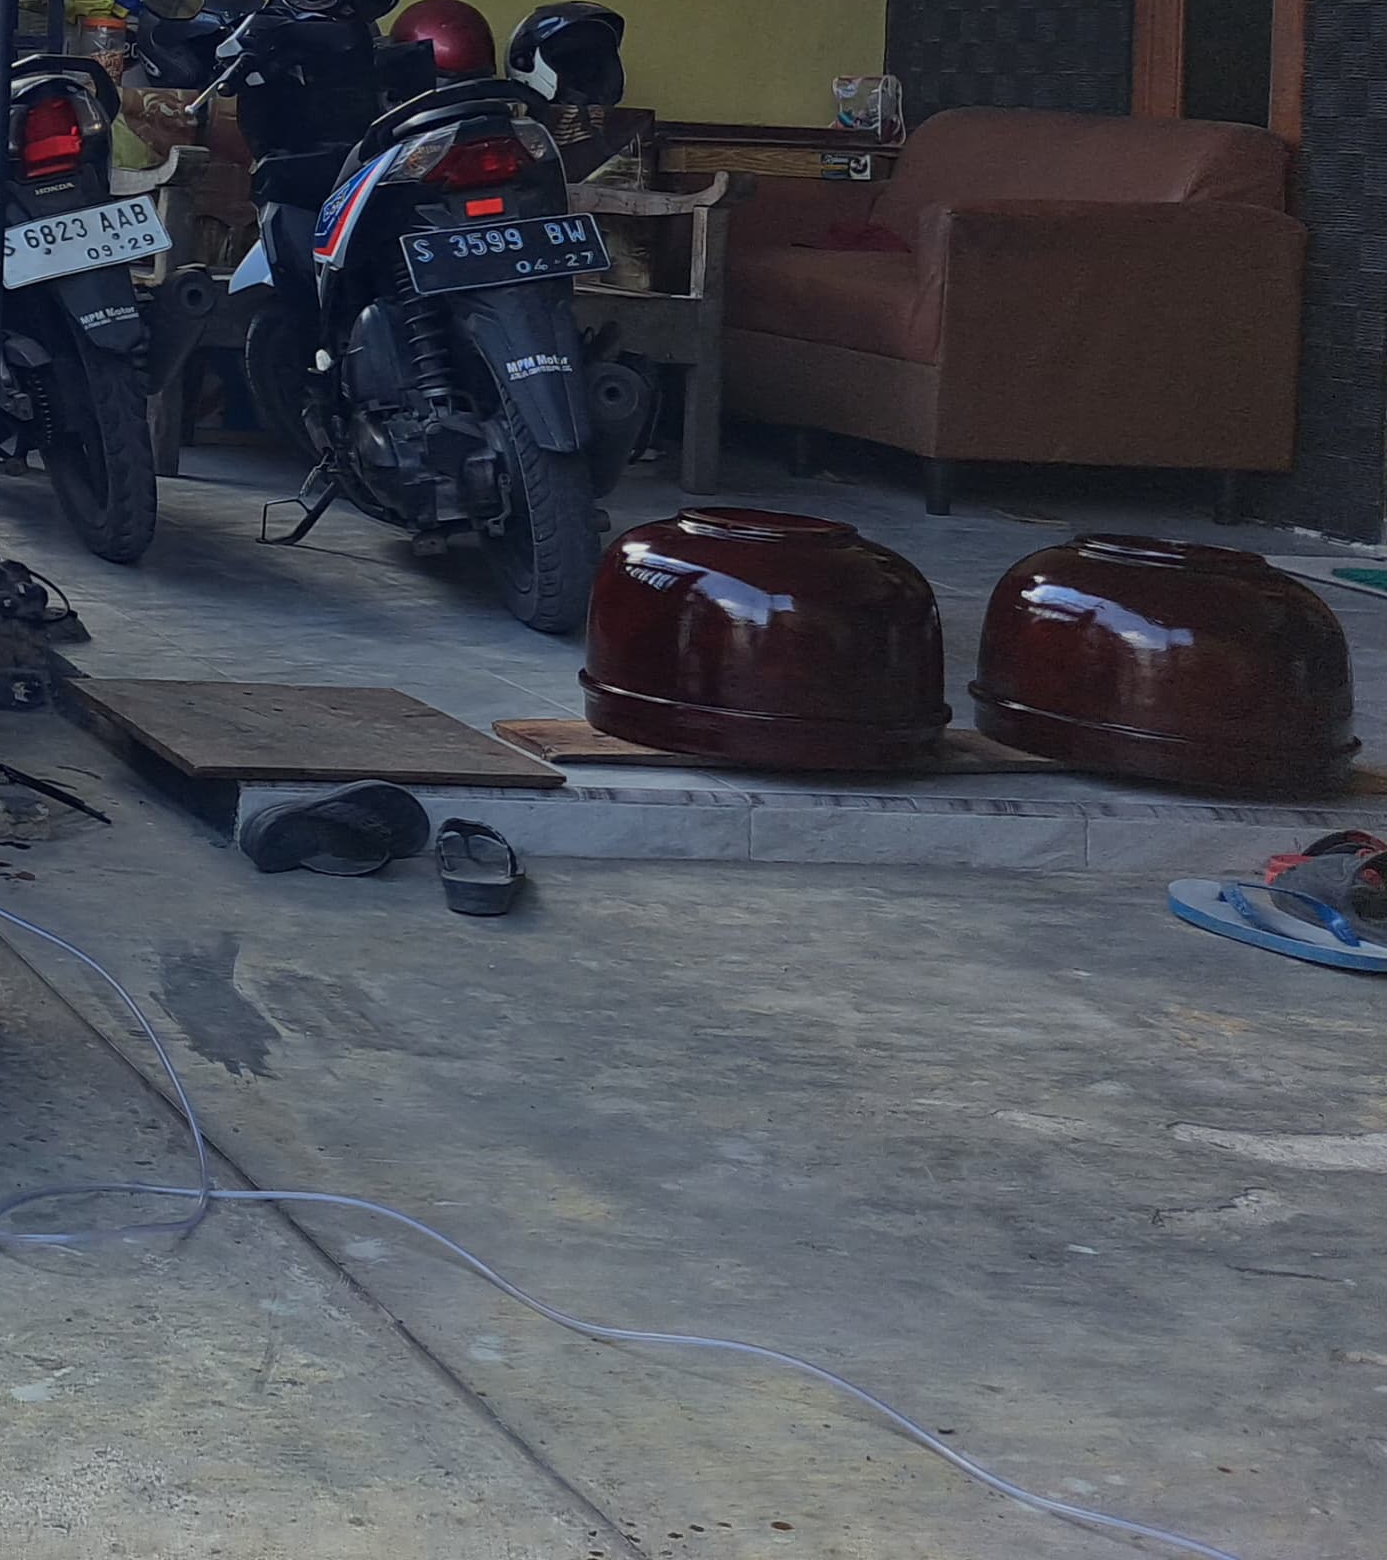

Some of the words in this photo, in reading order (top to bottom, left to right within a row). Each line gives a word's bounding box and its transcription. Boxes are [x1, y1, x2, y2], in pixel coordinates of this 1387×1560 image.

[35, 182, 76, 195] HONDA
[23, 218, 88, 249] 6823
[99, 203, 148, 232] AAB
[412, 239, 434, 263] S
[449, 227, 524, 258] 3599
[544, 219, 587, 245] BW
[505, 356, 536, 374] MPM
